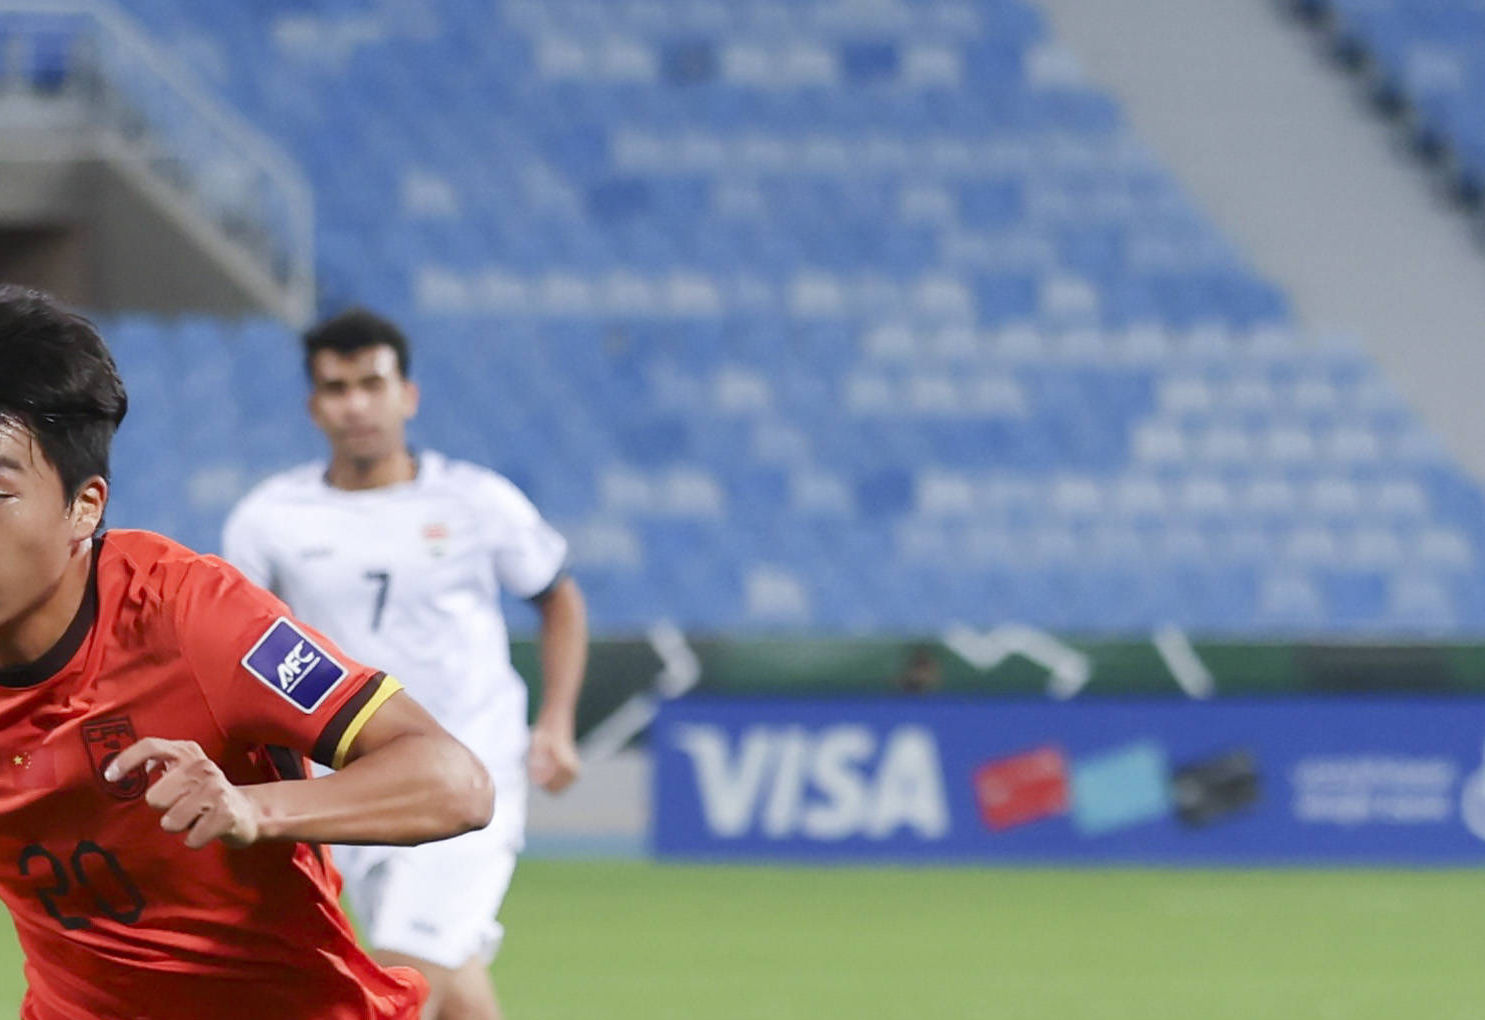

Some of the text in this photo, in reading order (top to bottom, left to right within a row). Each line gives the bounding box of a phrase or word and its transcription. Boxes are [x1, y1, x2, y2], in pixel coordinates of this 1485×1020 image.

[364, 570, 391, 632] 7
[277, 639, 315, 690] AFC
[672, 724, 949, 840] VISA
[19, 841, 145, 930] 20
